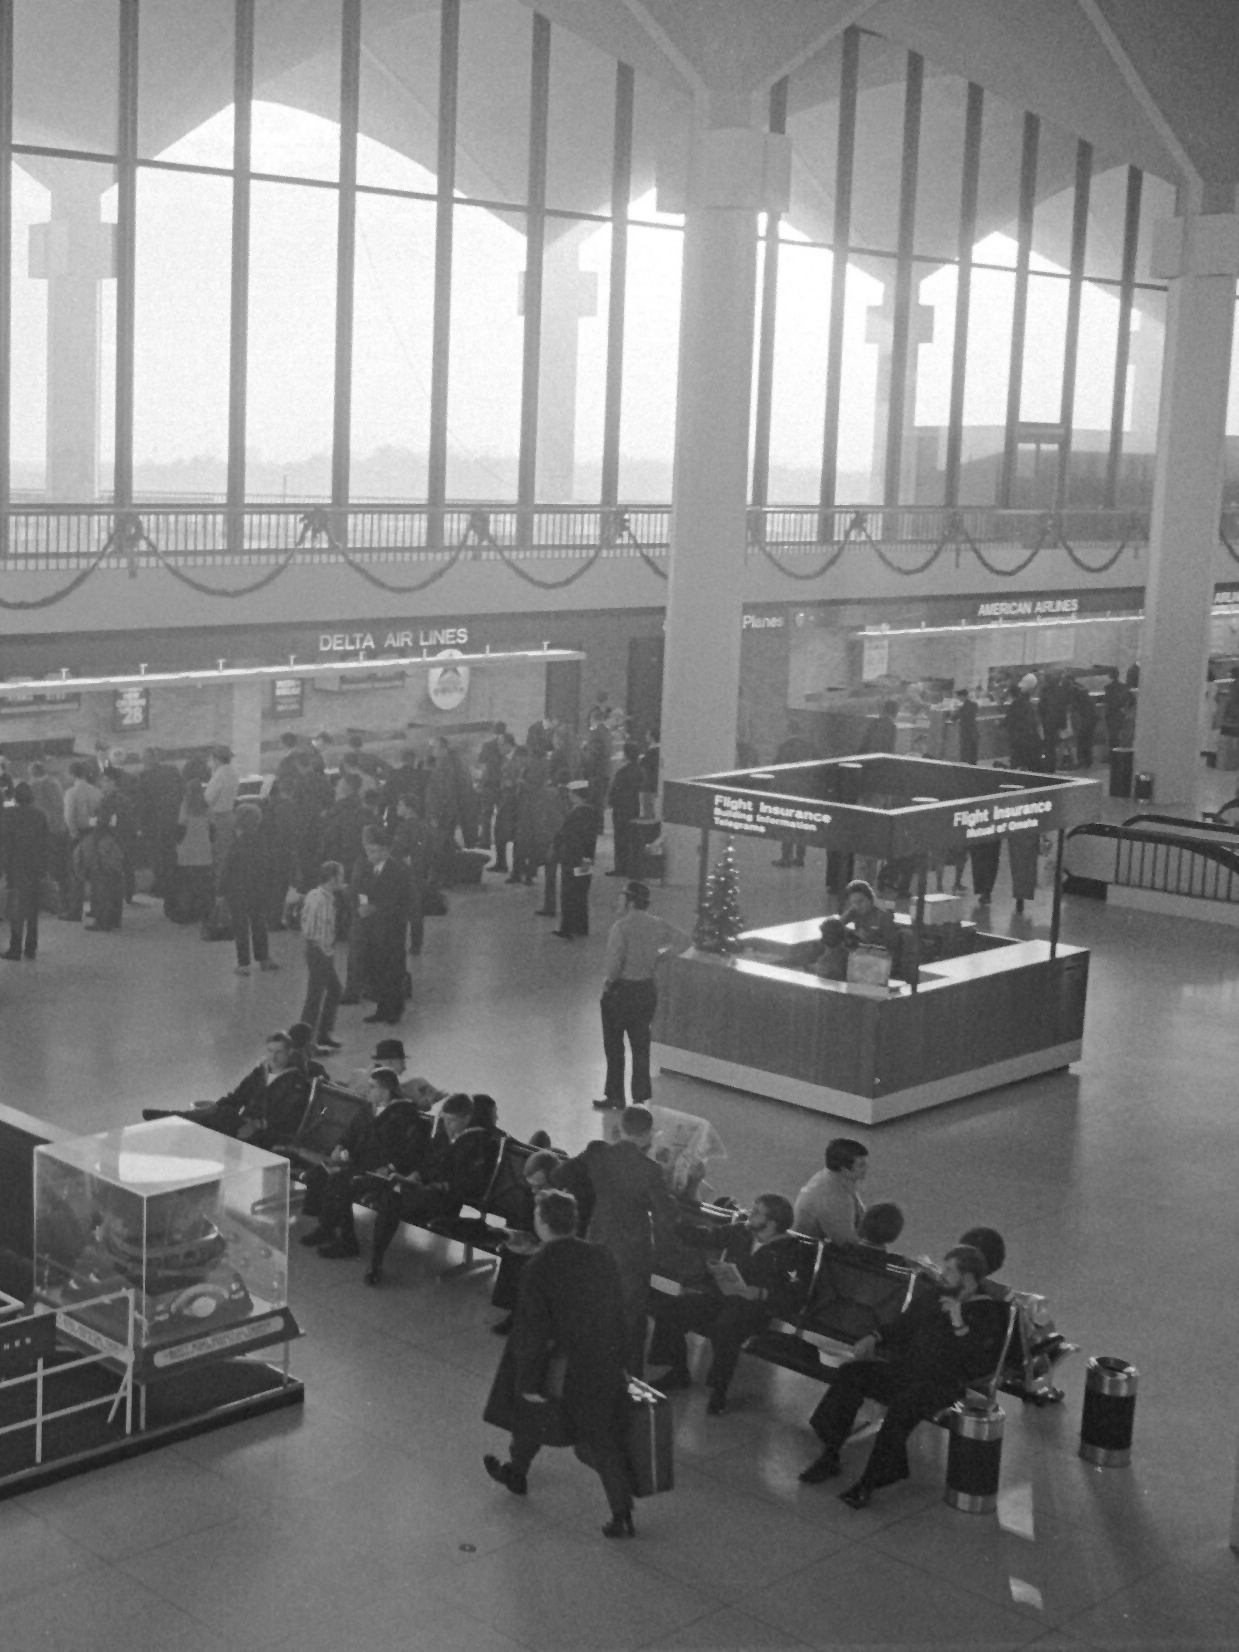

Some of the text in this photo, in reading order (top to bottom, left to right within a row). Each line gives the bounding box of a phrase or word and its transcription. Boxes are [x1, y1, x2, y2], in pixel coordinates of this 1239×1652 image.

[977, 601, 1033, 616] AMERICAN
[741, 614, 785, 629] Planes
[319, 628, 469, 651] DELTA AIR LINES
[714, 794, 832, 824] Flight Insurance
[953, 800, 1053, 828] Flight Insurance
